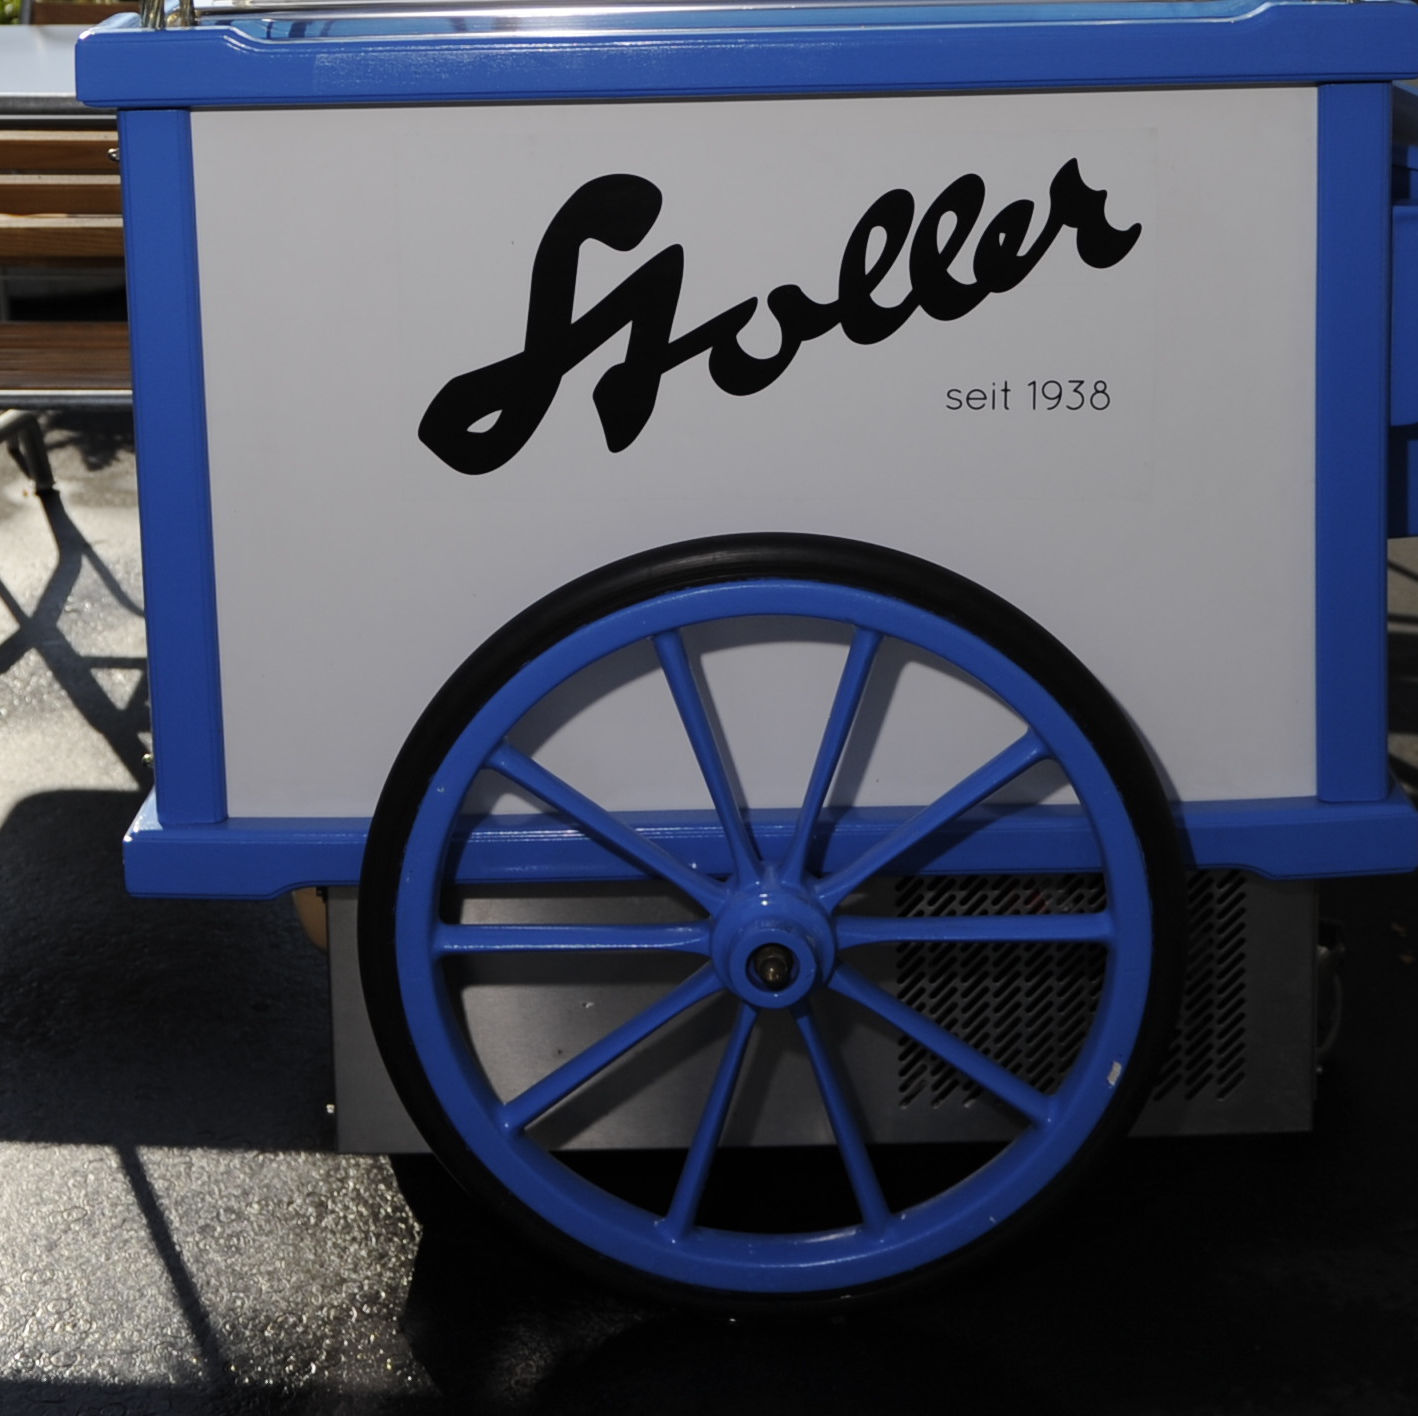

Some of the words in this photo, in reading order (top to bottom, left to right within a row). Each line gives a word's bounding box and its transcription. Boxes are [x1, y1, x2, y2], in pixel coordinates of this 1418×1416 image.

[417, 157, 1143, 476] Stoller
[945, 380, 1012, 411] seit
[1027, 380, 1111, 411] 1938
